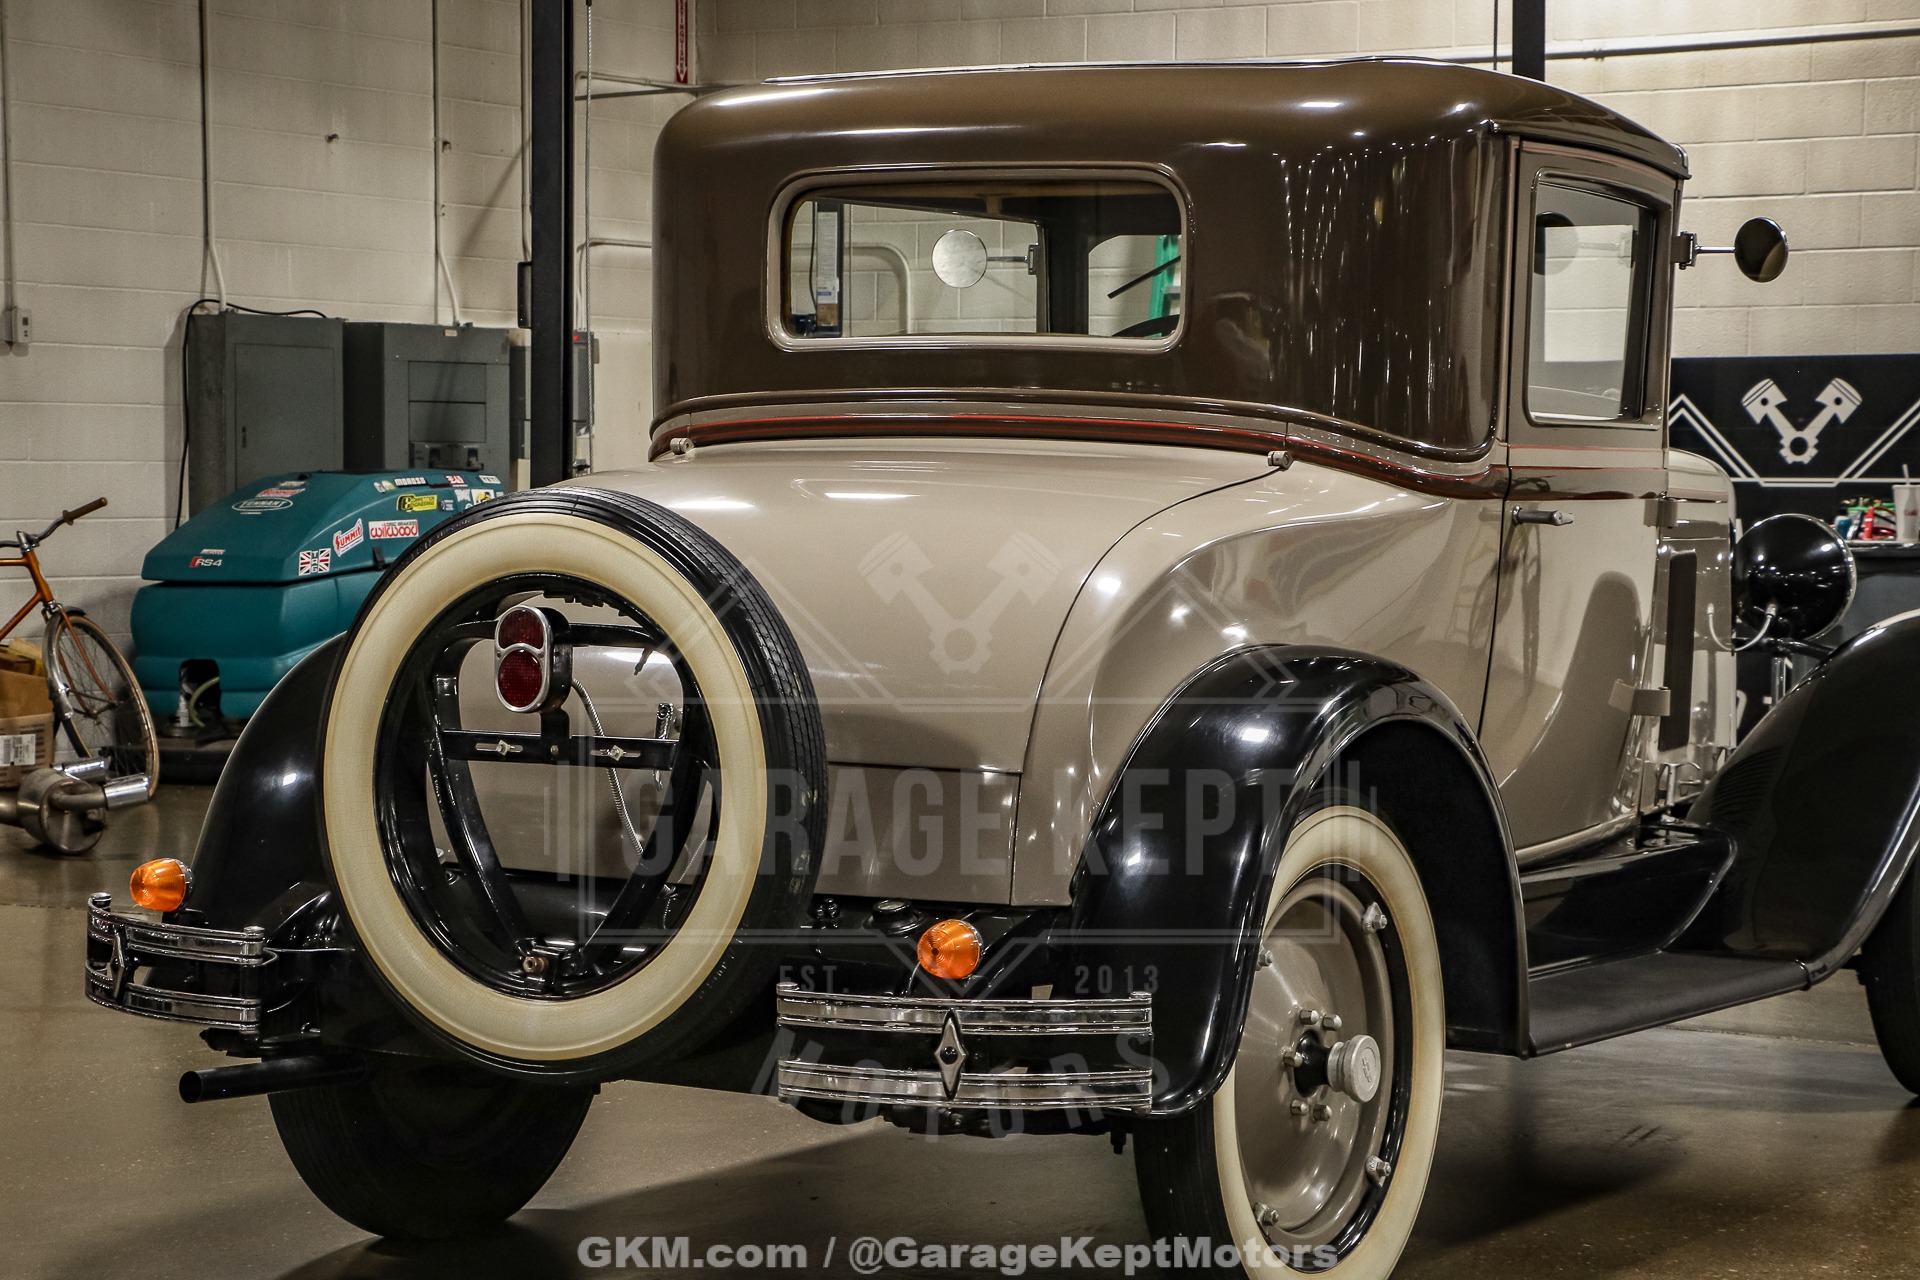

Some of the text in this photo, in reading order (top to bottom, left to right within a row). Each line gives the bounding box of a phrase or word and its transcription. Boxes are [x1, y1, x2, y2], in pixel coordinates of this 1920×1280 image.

[240, 500, 286, 508] TENNANT
[370, 521, 418, 538] wilwood
[335, 525, 361, 551] SUMMIT
[195, 558, 223, 567] RS4
